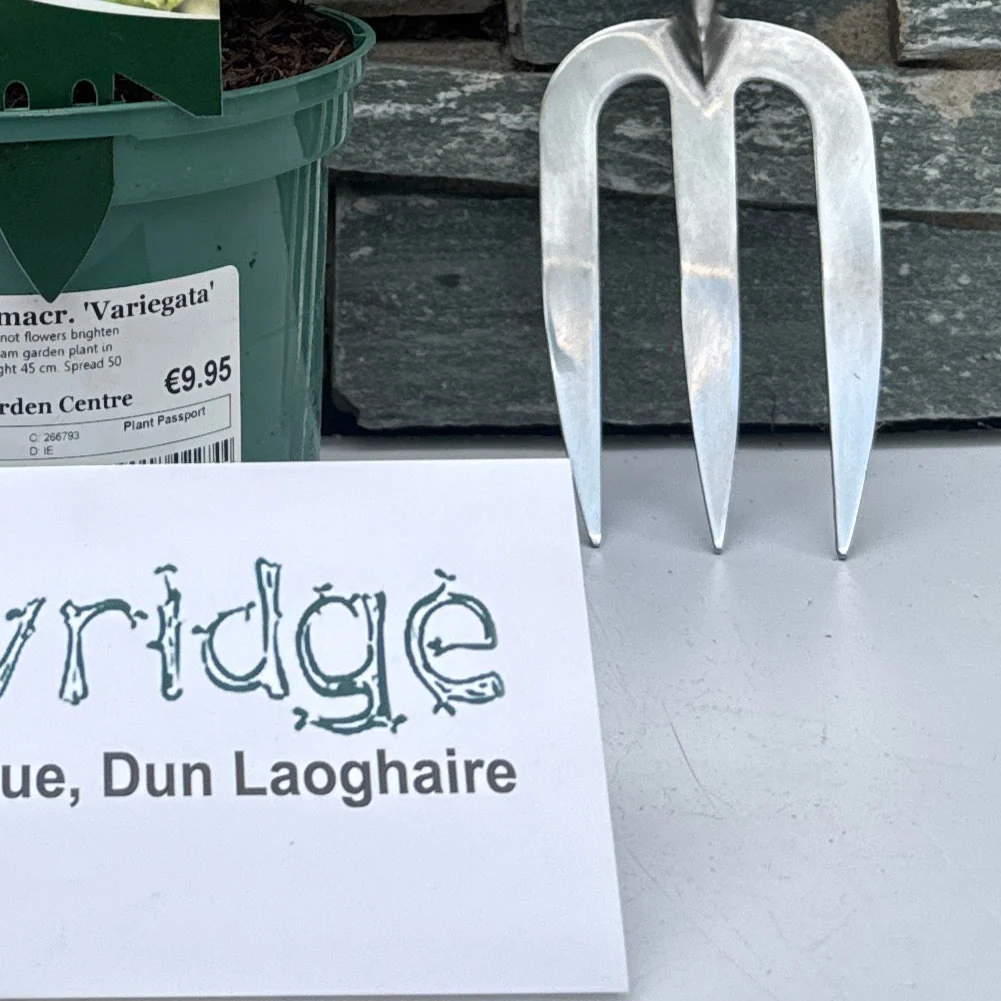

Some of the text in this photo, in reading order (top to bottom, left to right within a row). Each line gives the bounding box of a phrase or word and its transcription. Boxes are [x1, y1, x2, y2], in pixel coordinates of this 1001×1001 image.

[84, 281, 214, 320] 'Variegata'
[25, 331, 67, 342] flowers
[71, 327, 119, 341] brighten
[23, 346, 64, 361] garden
[69, 344, 98, 358] plant
[102, 344, 113, 352] in
[20, 362, 35, 374] 45
[64, 357, 104, 374] Spread
[108, 355, 122, 367] 50
[164, 355, 233, 394] €9.95
[59, 393, 133, 413] Centre
[123, 406, 206, 432] Plant Passport
[43, 431, 80, 442] 266793
[103, 751, 212, 797] Dun
[234, 748, 517, 808] Laoghaire
